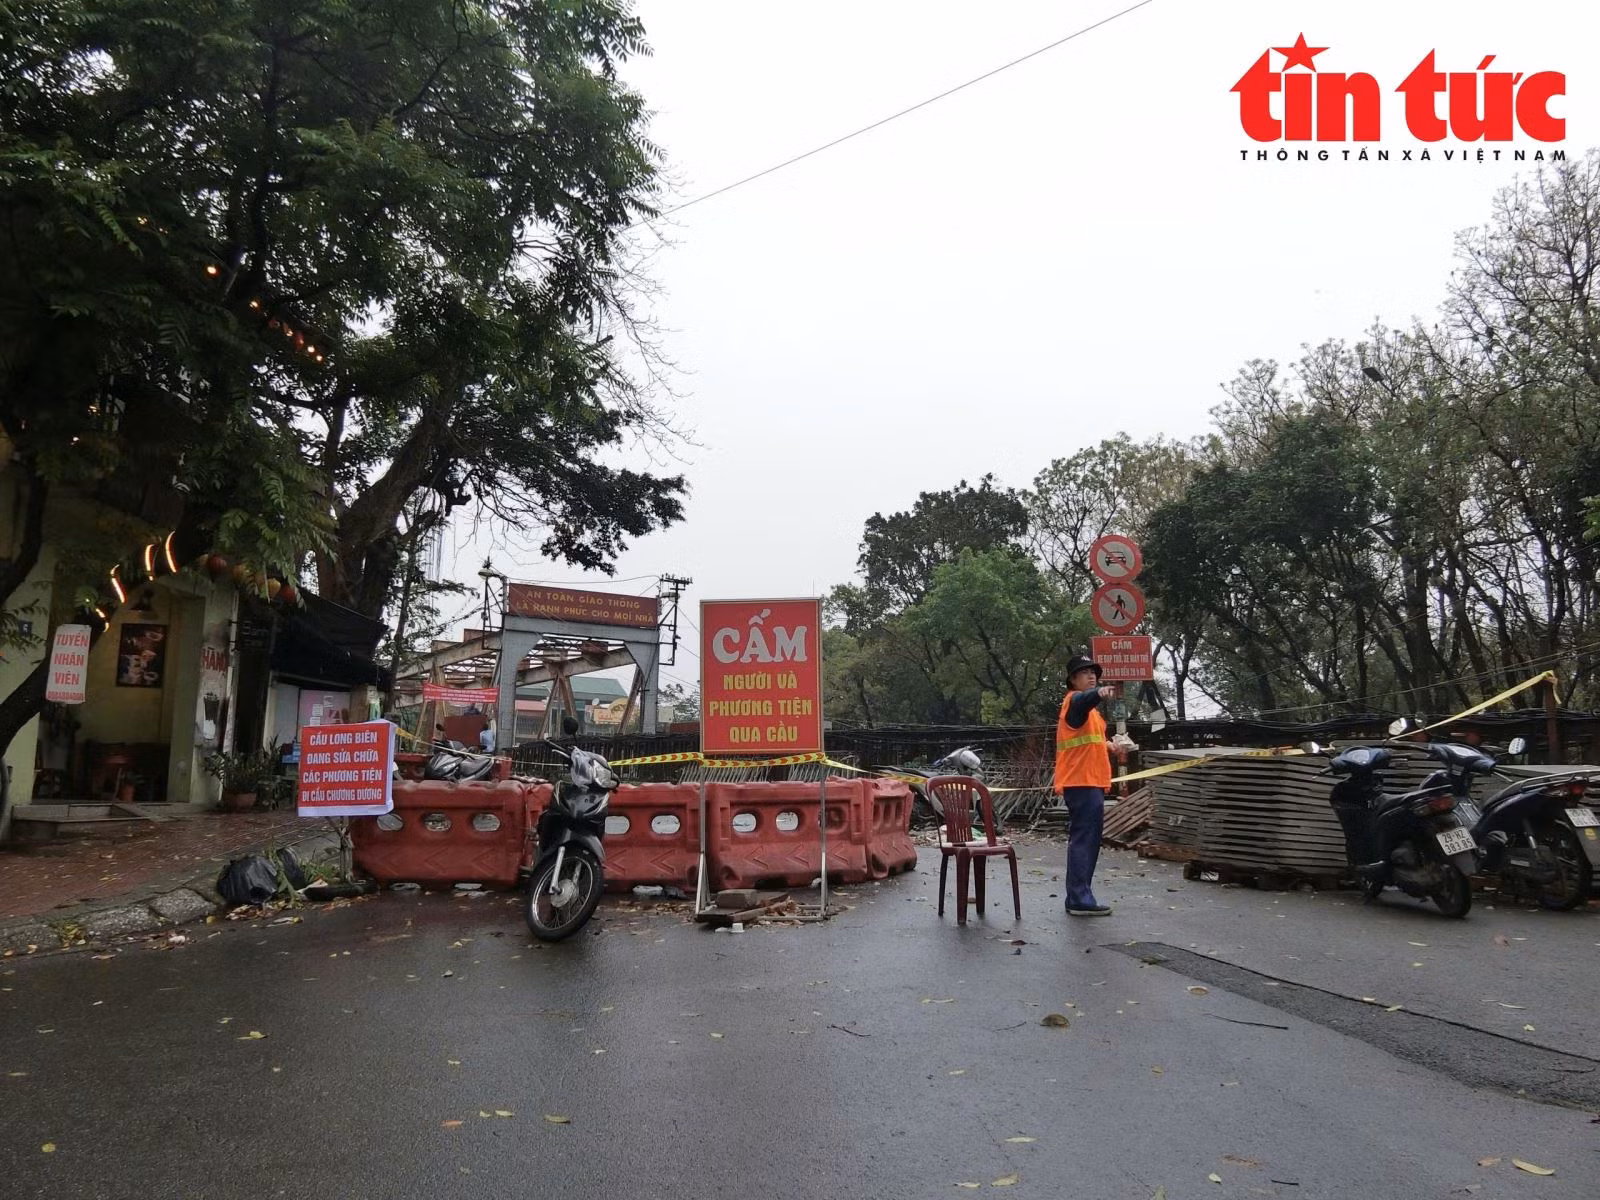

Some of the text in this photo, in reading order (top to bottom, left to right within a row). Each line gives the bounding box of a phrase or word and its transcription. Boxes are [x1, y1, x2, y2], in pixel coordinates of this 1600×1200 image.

[527, 590, 541, 599] AN
[712, 608, 807, 664] CẤM
[54, 652, 84, 666] NHÂN
[55, 670, 80, 686] VIÊN
[723, 670, 798, 690] NGƯỜI VÀ
[709, 697, 813, 719] PHƯƠNG TIỆN
[329, 732, 353, 745] LONG
[355, 730, 377, 744] BIÊN
[729, 720, 798, 743] QUA CẦU
[354, 748, 379, 763] CHỮA
[303, 767, 383, 784] CÁC PHƯƠNG TIỆN
[326, 788, 355, 801] CHƯƠNG
[357, 788, 382, 800] DƯƠNG
